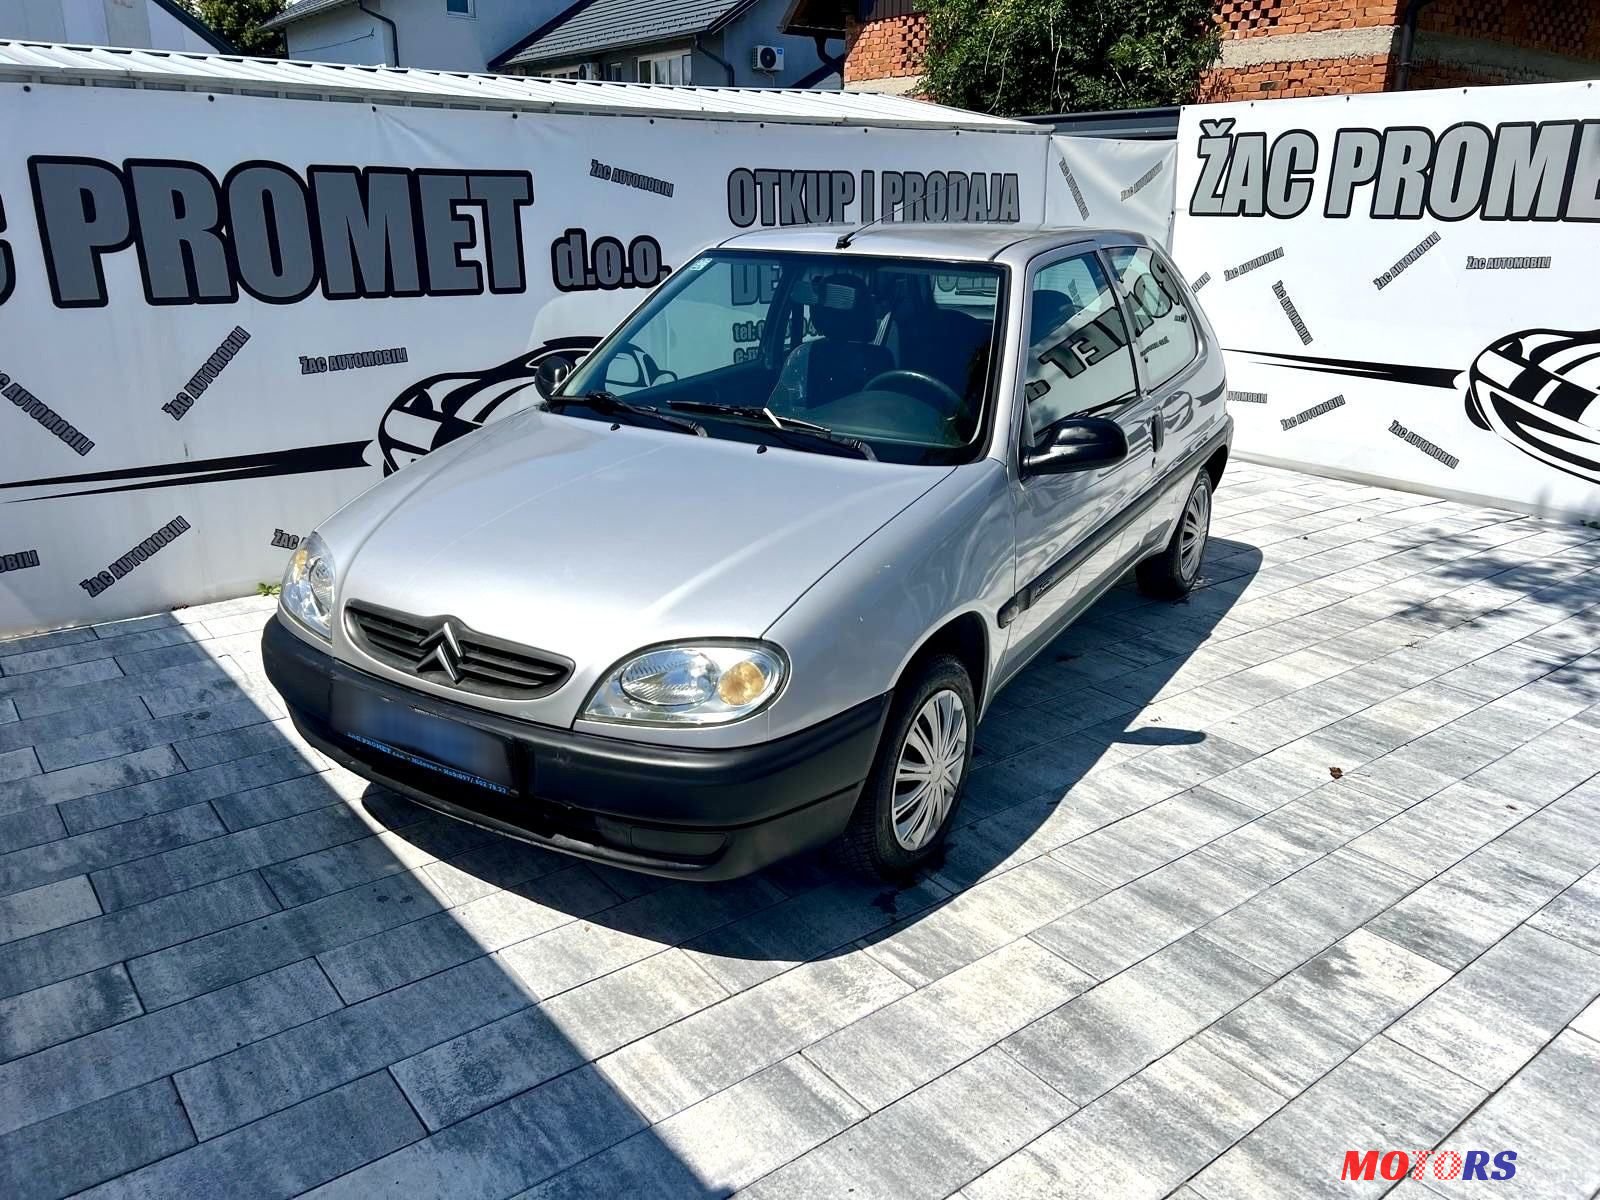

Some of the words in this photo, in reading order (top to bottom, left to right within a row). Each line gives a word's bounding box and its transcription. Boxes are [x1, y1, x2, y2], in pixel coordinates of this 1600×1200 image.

[590, 159, 612, 180] ŽAC
[611, 168, 674, 197] AUTOMOBILI
[1189, 118, 1319, 219] ŽAC
[728, 168, 855, 228] OTKUP
[881, 170, 1020, 224] PRODAJA
[28, 155, 534, 309] PROMET
[1389, 231, 1441, 278] AUTOMOBILI
[1239, 247, 1284, 275] AUTOMOBILI
[1486, 256, 1551, 269] AUTOMOBILI
[1280, 296, 1313, 345] AUTOMOBILI
[161, 392, 194, 420] ŽAC
[184, 325, 251, 399] AUTOMOBILI
[299, 356, 327, 375] ŽAC
[328, 347, 408, 371] AUTOMOBILI
[1, 382, 95, 456] AUTOMOBILI
[1297, 394, 1345, 425] AUTOMOBILI
[1404, 431, 1459, 469] AUTOMOBILI
[80, 571, 115, 598] ŽAC
[108, 515, 191, 580] AUTOMOBILI
[270, 528, 300, 550] ŽAC
